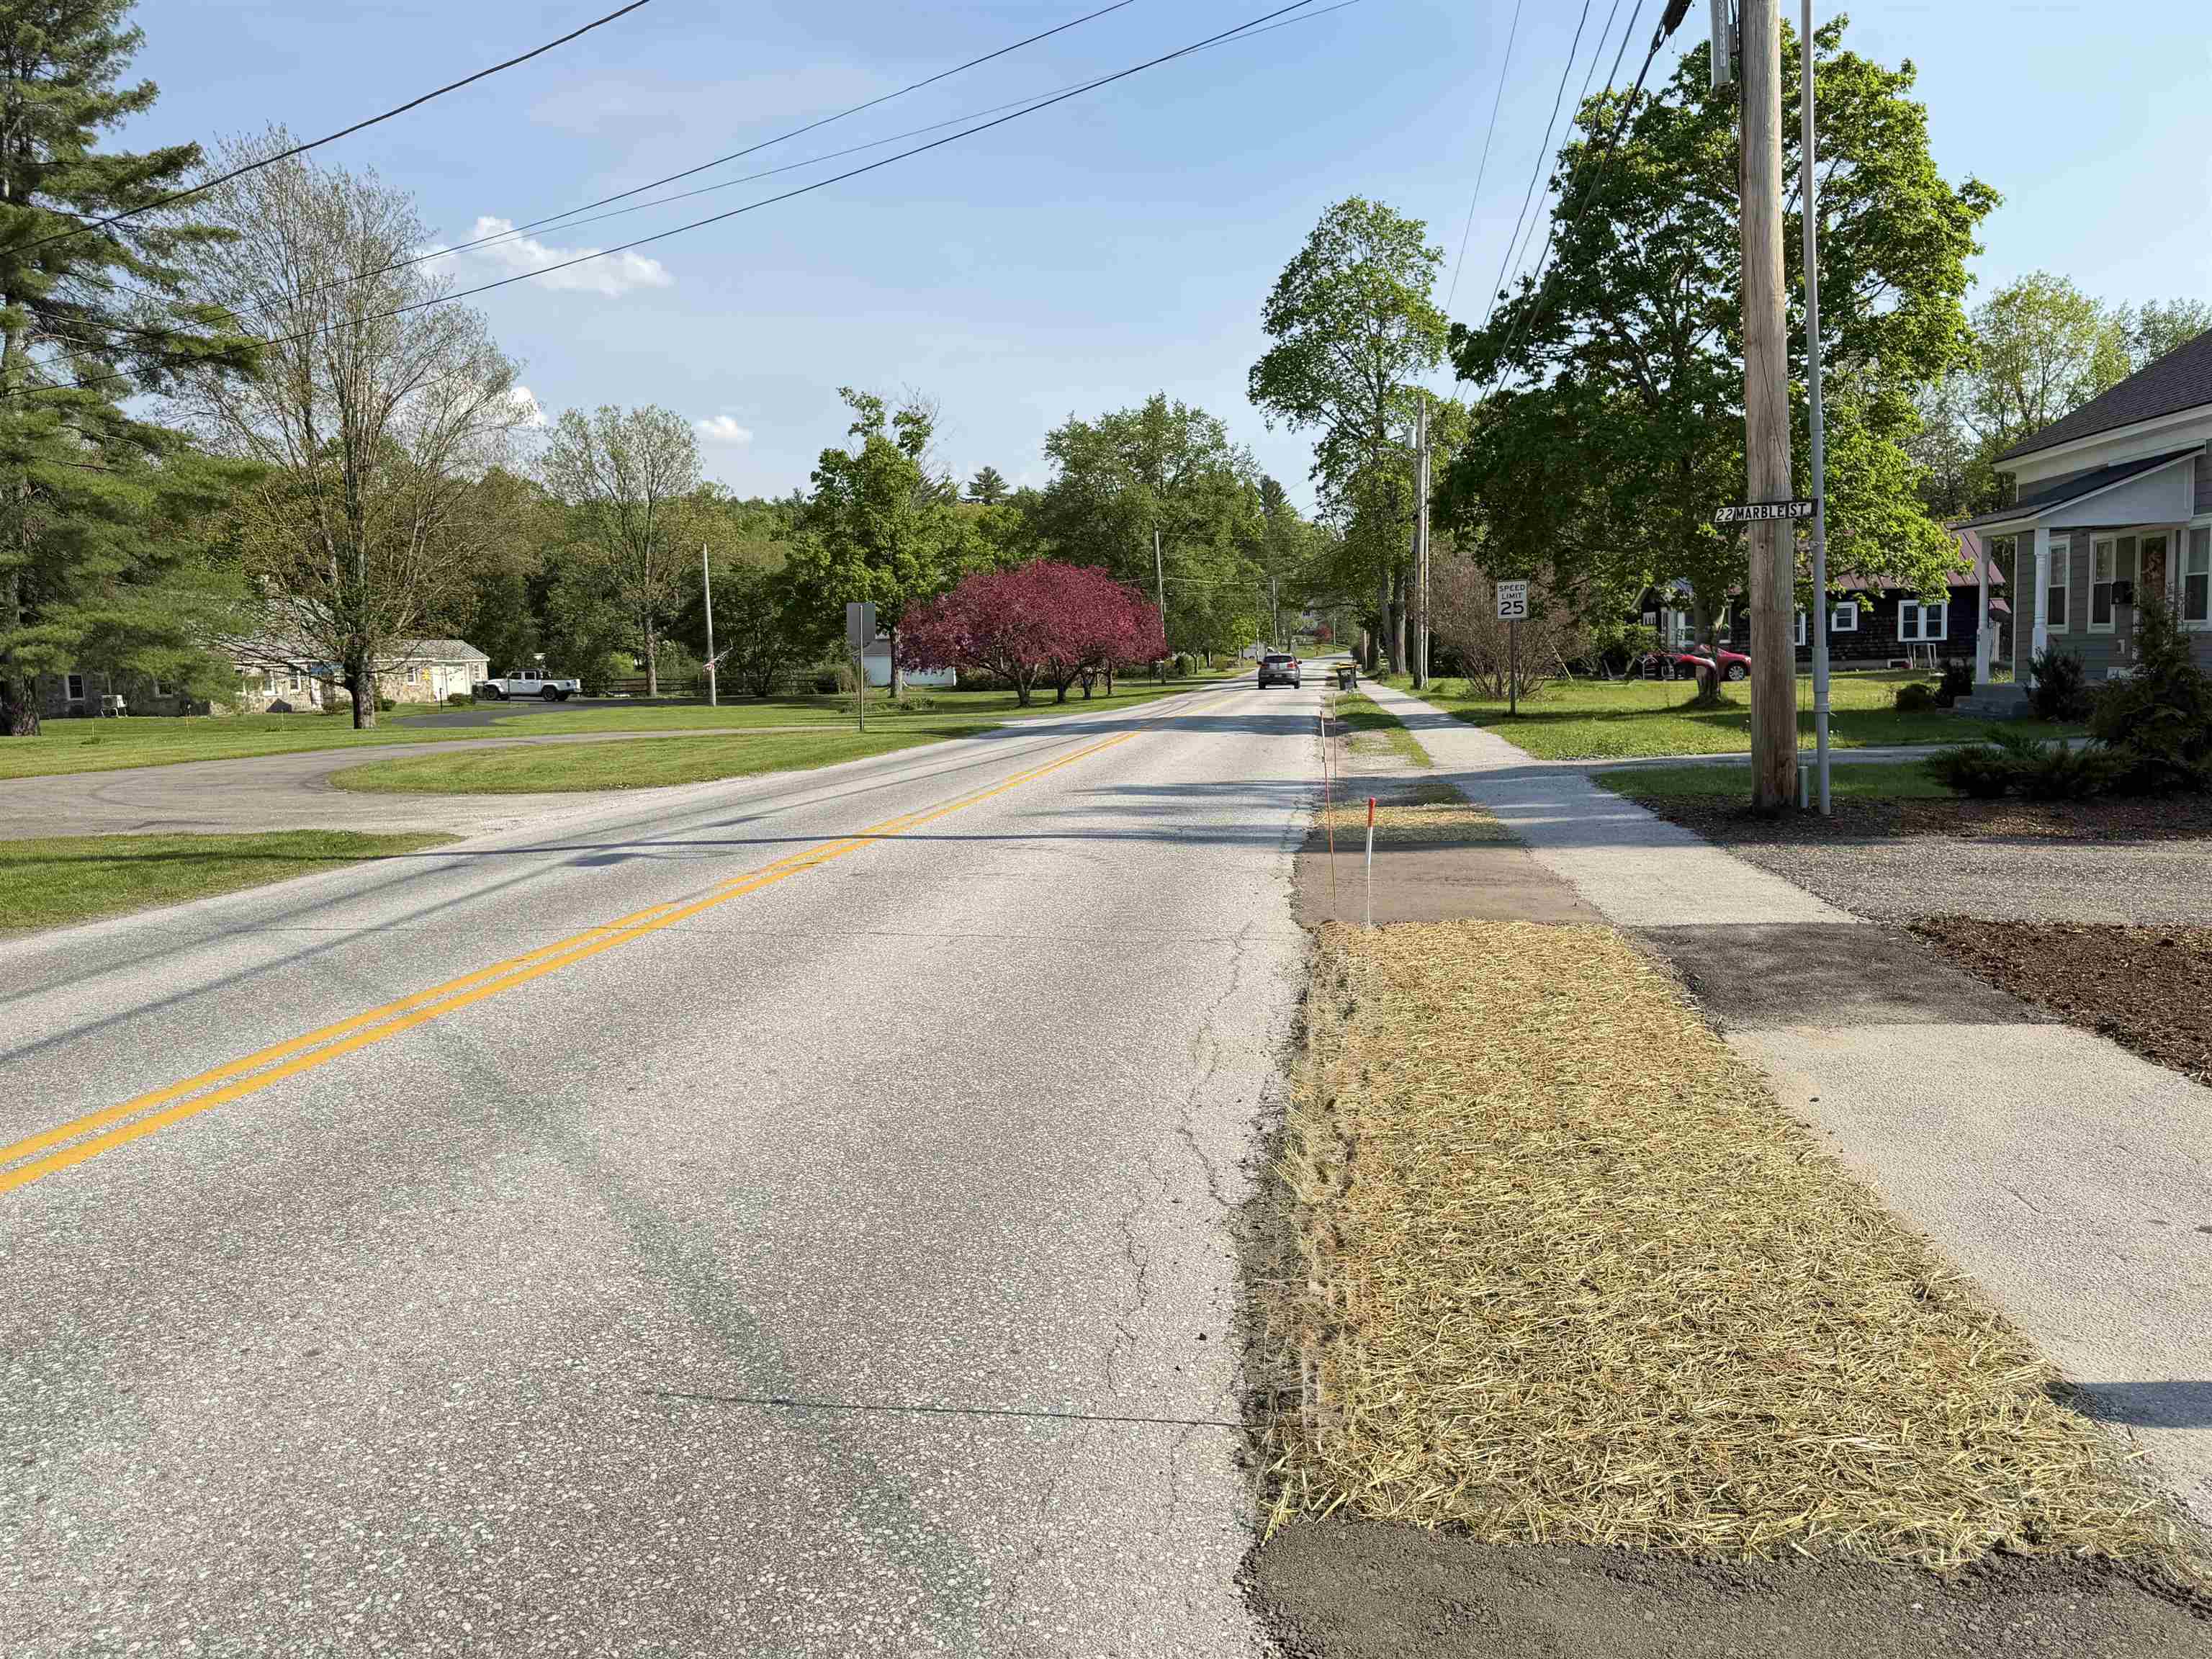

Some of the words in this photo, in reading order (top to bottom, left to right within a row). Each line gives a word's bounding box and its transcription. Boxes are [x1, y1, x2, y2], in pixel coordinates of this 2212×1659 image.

[1716, 508, 1732, 521] 22
[1736, 505, 1784, 519] MARBLE
[1501, 601, 1524, 616] 25
